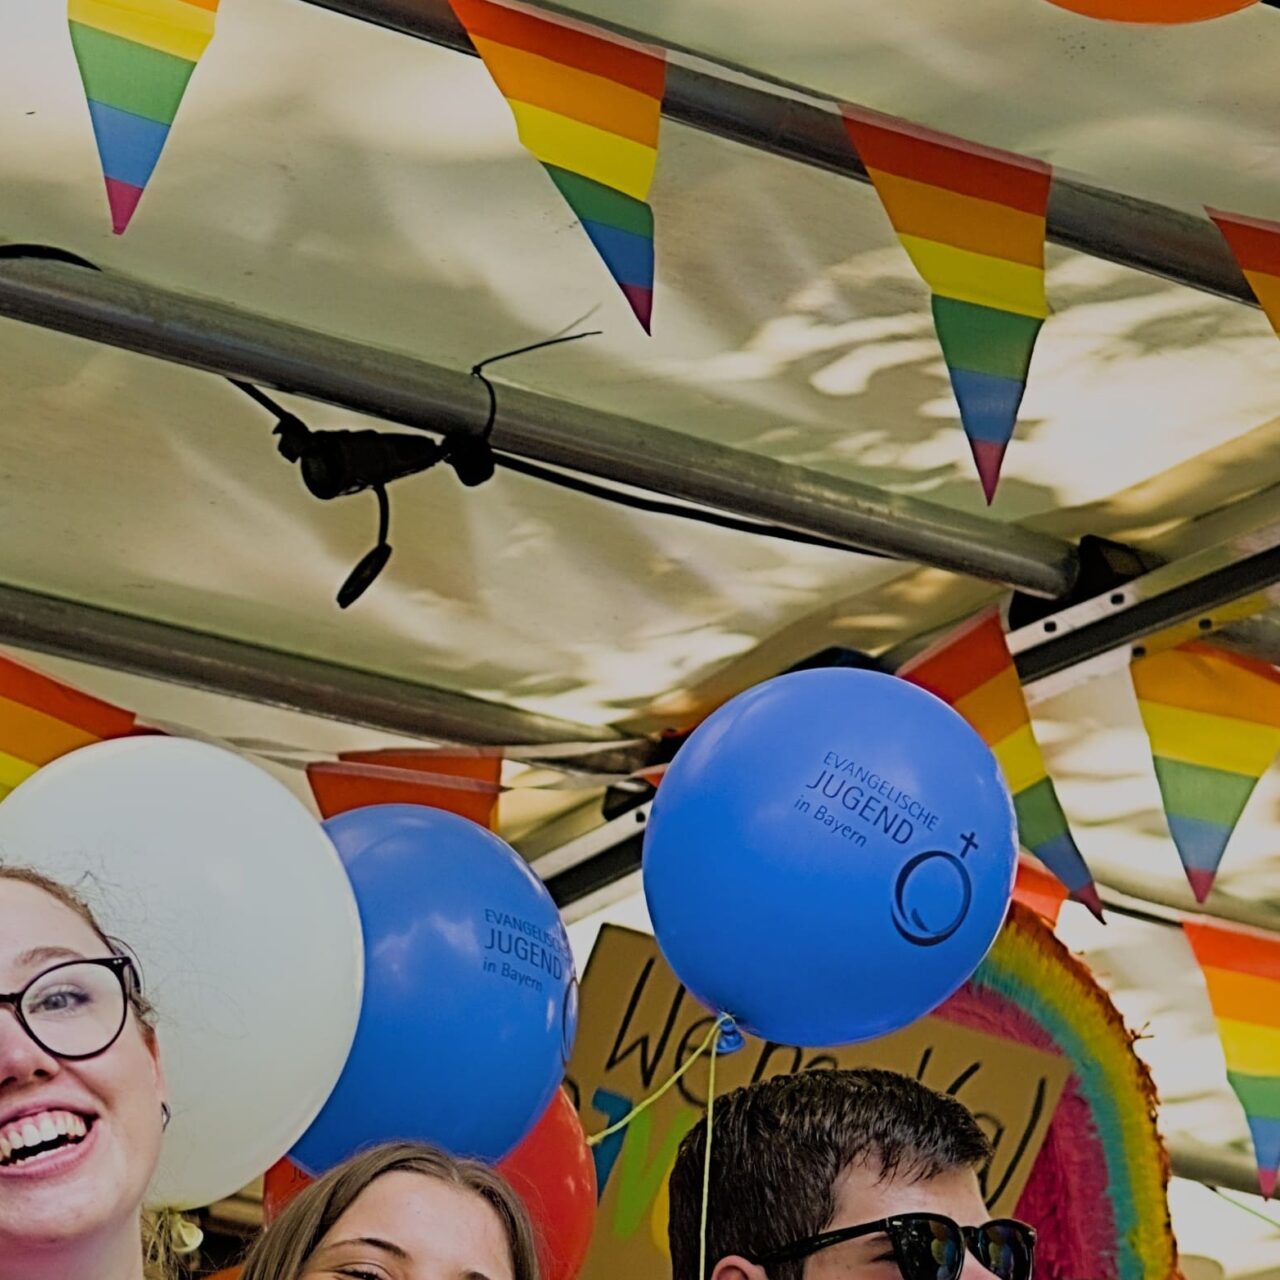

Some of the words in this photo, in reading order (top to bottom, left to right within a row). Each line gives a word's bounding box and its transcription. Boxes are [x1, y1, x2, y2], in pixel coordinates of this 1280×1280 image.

[806, 770, 913, 844] JUGEND
[823, 751, 939, 832] EVANGELISCHE
[794, 795, 810, 813] in
[814, 806, 868, 848] Bayern
[483, 957, 496, 973] in
[501, 962, 542, 992] Bayern
[484, 928, 562, 980] JUGEND
